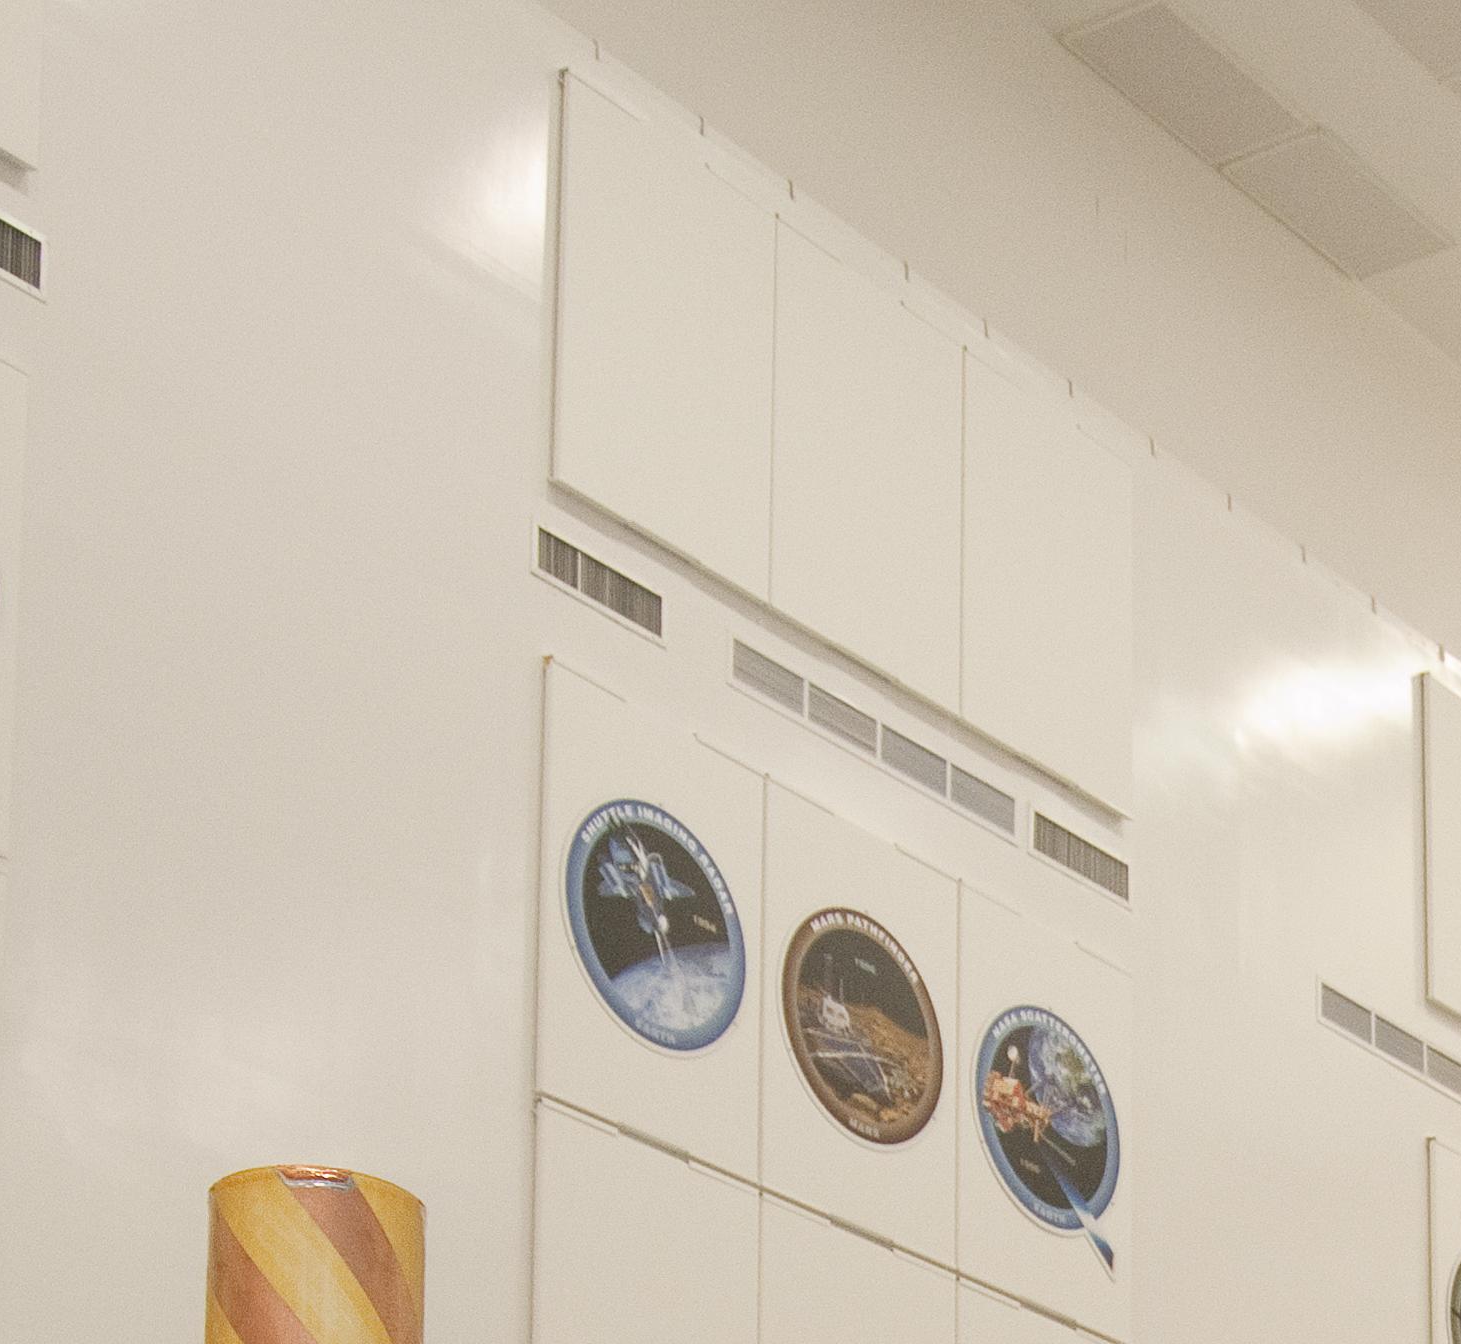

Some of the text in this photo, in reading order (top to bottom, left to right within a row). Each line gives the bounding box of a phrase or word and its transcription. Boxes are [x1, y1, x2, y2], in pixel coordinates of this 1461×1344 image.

[581, 804, 734, 915] SHUTTLE IMAGING RADAR
[810, 911, 920, 984] MARS PATHFINDER
[992, 1012, 1018, 1039] NASA
